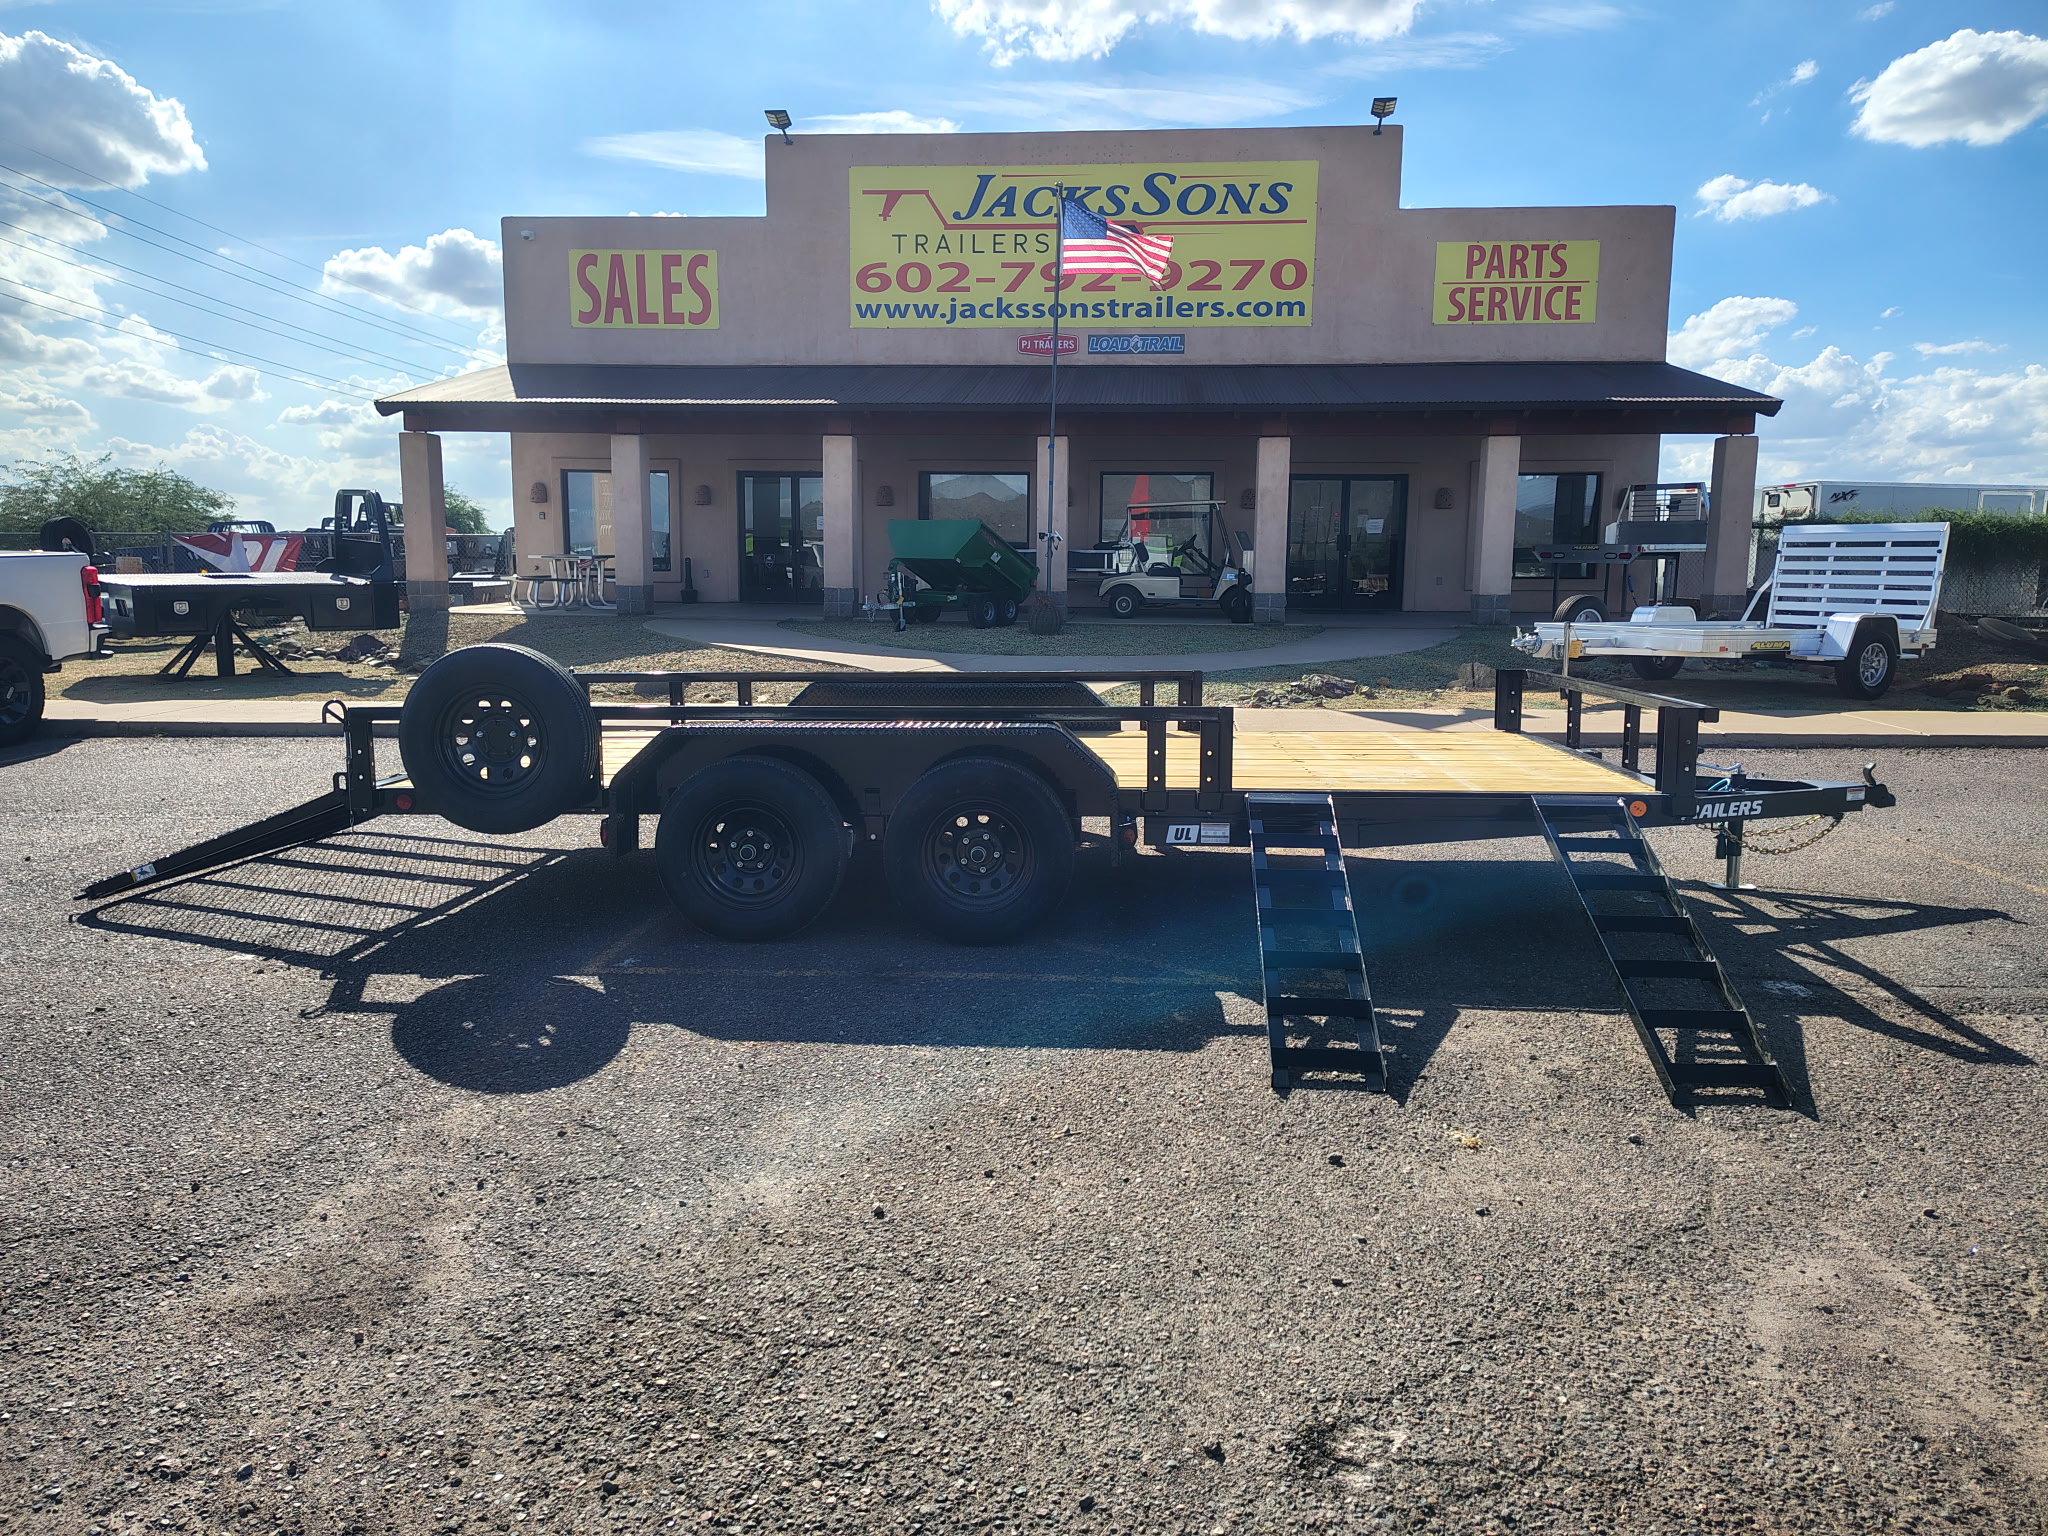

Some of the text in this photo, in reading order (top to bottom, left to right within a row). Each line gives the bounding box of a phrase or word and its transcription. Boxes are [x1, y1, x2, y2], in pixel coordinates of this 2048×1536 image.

[891, 233, 1050, 254] TRAILERS
[1465, 243, 1568, 279] PARTS
[576, 253, 712, 325] SALES
[855, 295, 1306, 325] www.jackssonstrailers.com
[1447, 286, 1582, 322] SERVICE
[1021, 340, 1075, 349] PJ TRAIERS
[1088, 337, 1185, 352] LOAD TRAIL
[1827, 489, 1862, 503] NXT
[1752, 641, 1790, 650] ALUMA
[1173, 827, 1192, 841] UL
